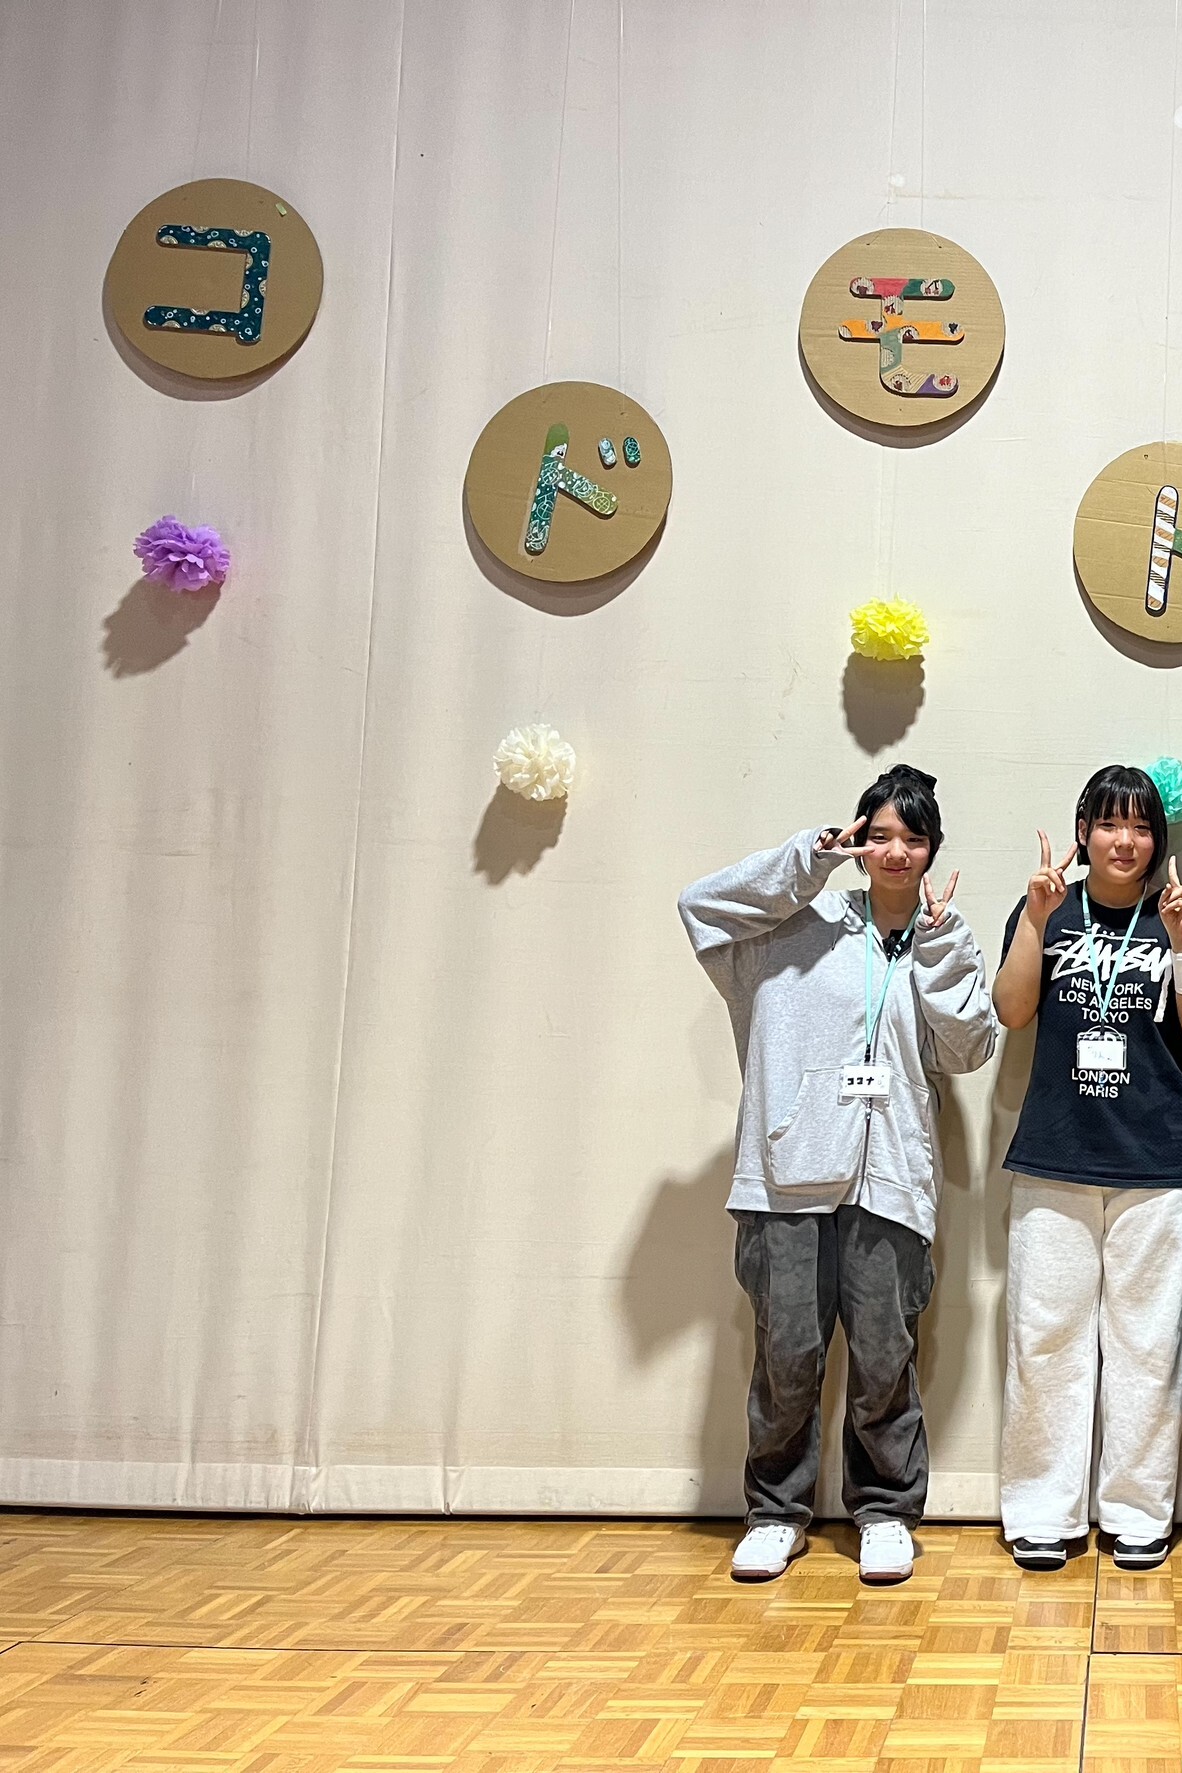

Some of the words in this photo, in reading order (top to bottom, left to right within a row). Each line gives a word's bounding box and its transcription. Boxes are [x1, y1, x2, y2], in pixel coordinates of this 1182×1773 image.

[143, 225, 271, 343] コ
[524, 422, 642, 555] ド
[838, 277, 965, 396] モ
[1058, 990, 1087, 1004] LOS
[1105, 982, 1145, 998] ORK
[1071, 1067, 1131, 1085] LONDON
[1079, 1083, 1119, 1099] PARIS
